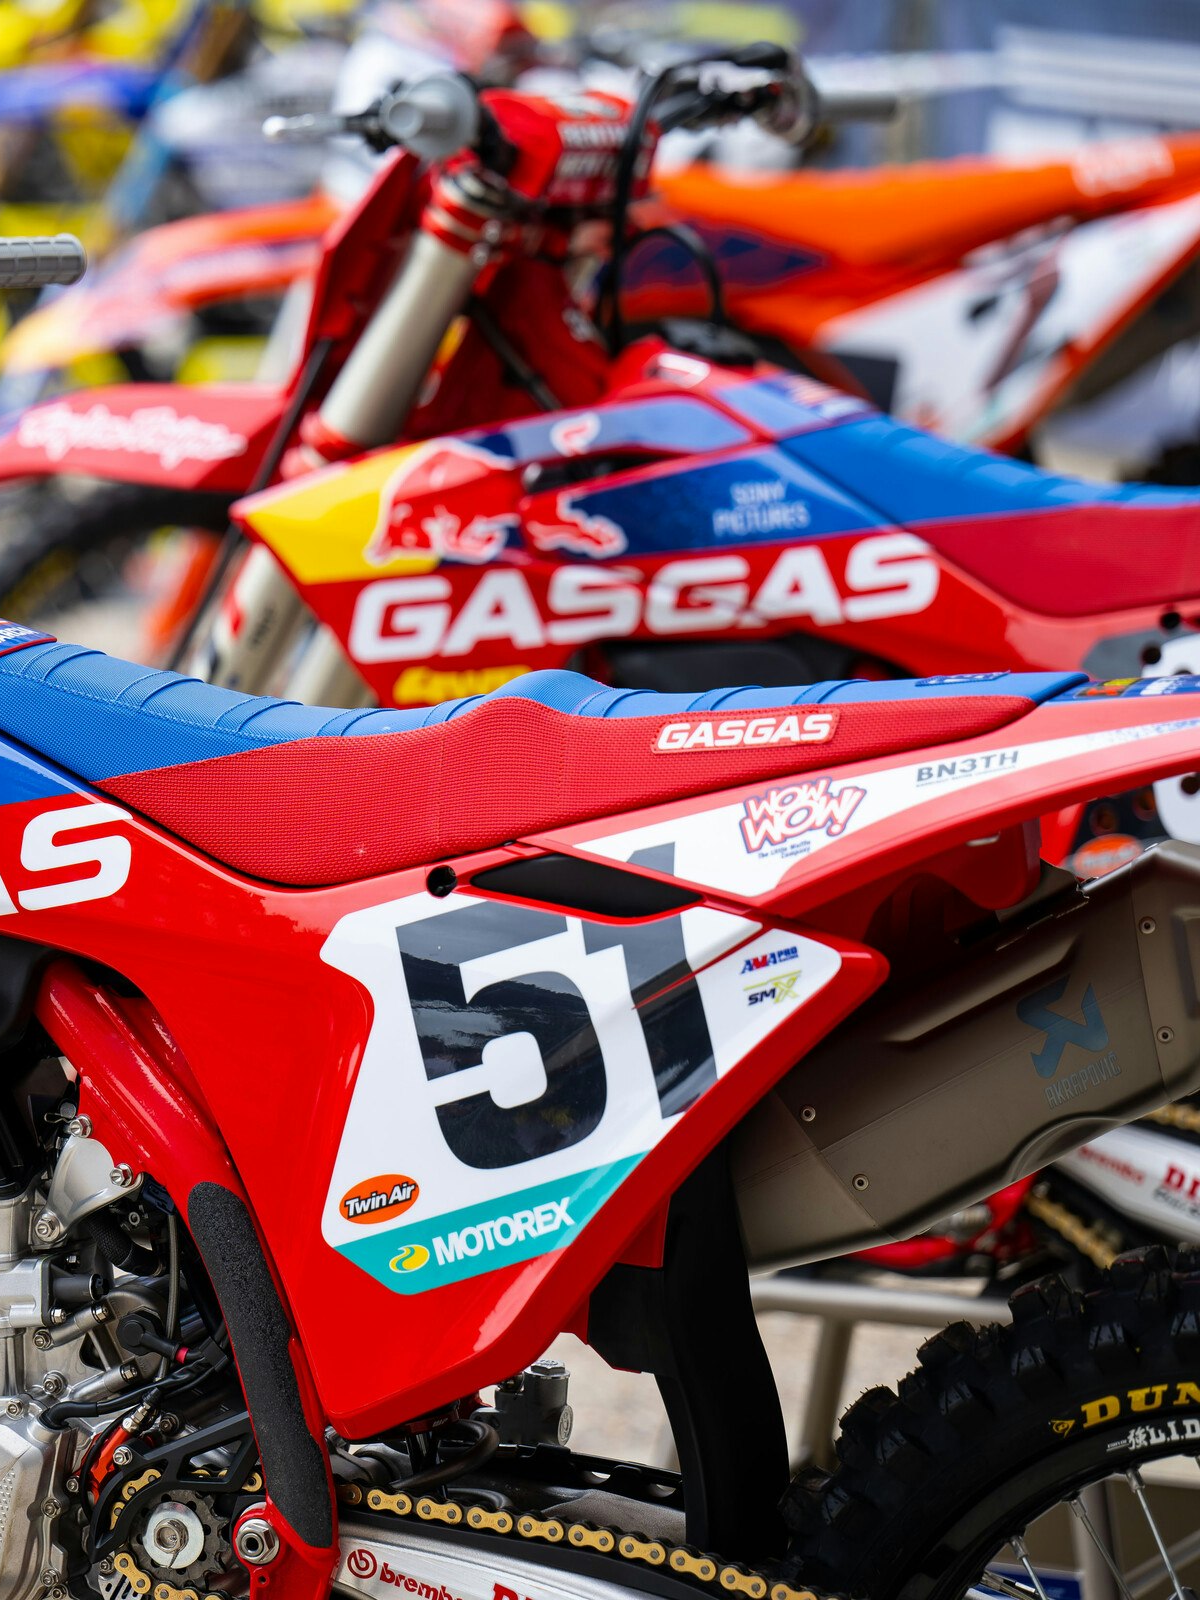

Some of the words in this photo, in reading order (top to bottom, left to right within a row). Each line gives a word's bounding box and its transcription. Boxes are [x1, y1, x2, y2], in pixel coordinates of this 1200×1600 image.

[348, 532, 940, 665] GASGAS
[657, 713, 834, 750] GASGAS
[917, 750, 1019, 782] BN3TH
[395, 842, 719, 1170] 51
[345, 1190, 388, 1218] Twin
[388, 1182, 417, 1204] Air
[431, 1196, 576, 1266] MOTOREX
[379, 1562, 463, 1600] bremb
